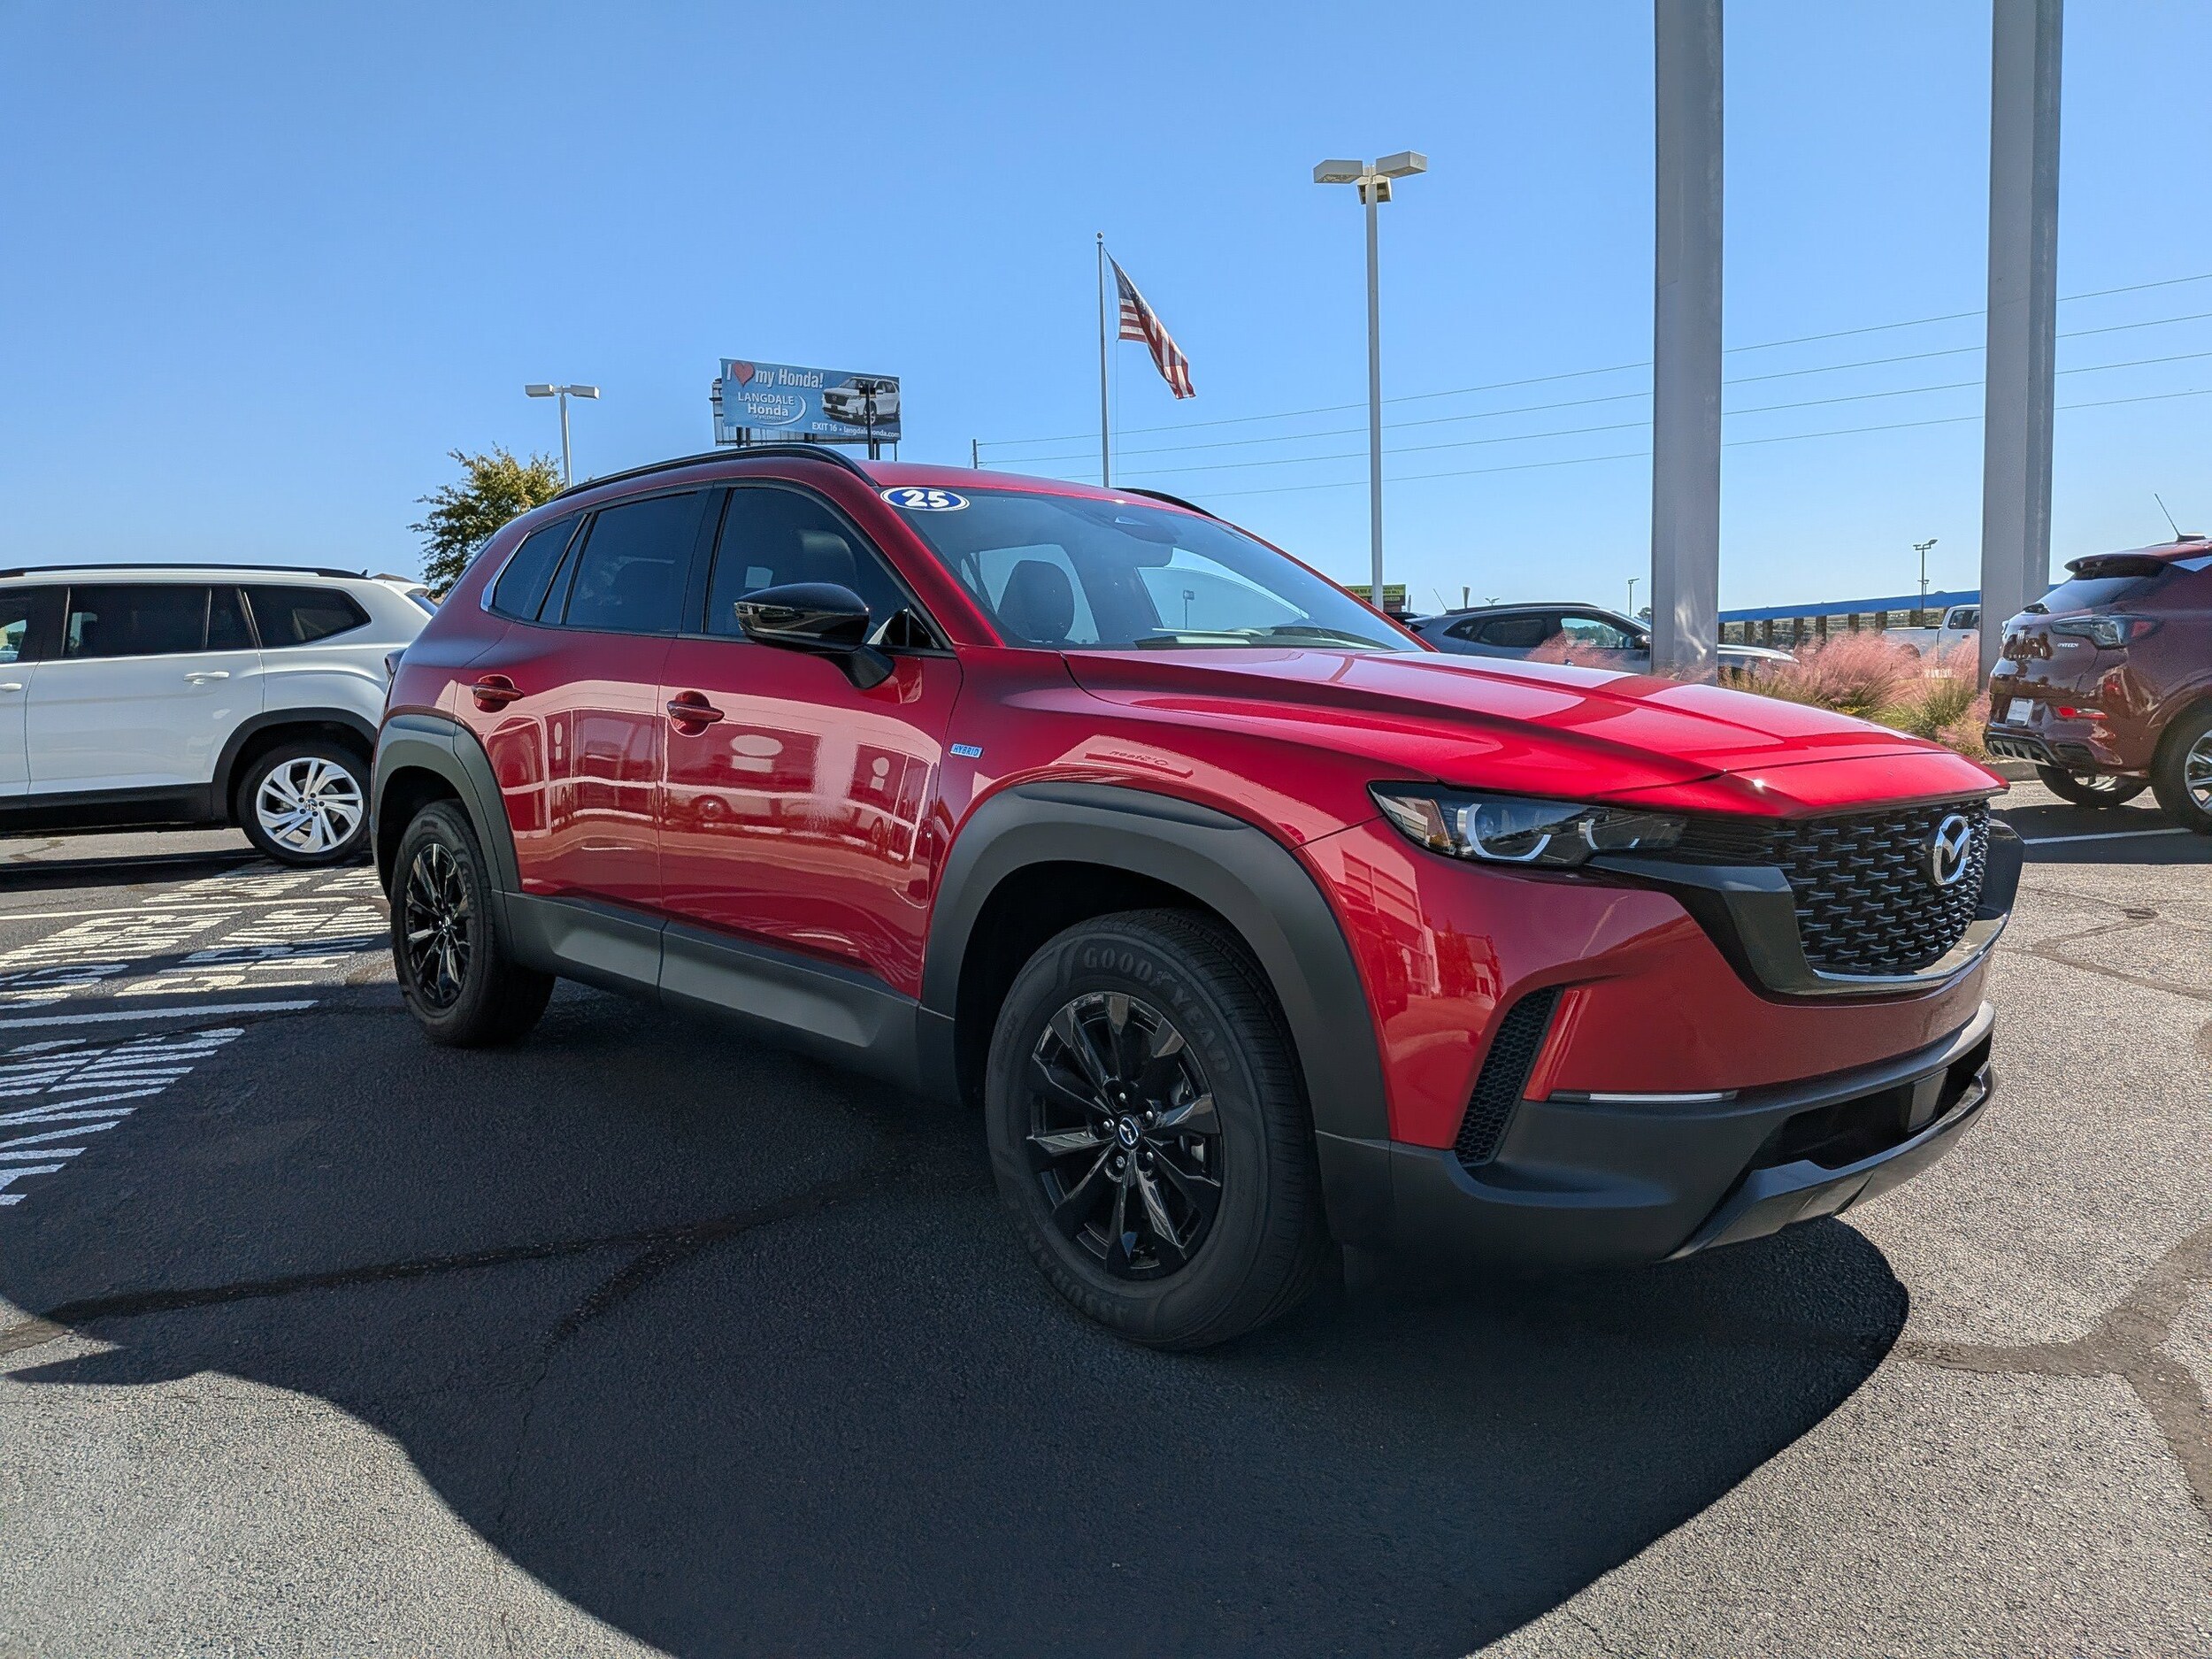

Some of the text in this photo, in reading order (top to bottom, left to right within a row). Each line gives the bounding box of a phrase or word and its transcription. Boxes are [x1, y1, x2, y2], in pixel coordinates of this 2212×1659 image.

[726, 363, 825, 389] I my Honda!
[737, 392, 795, 406] LANGDALE
[747, 403, 790, 418] Honda
[828, 423, 838, 432] 16
[843, 426, 901, 438] langdalonda.com
[902, 489, 949, 508] 25
[953, 744, 980, 757] HYBRID
